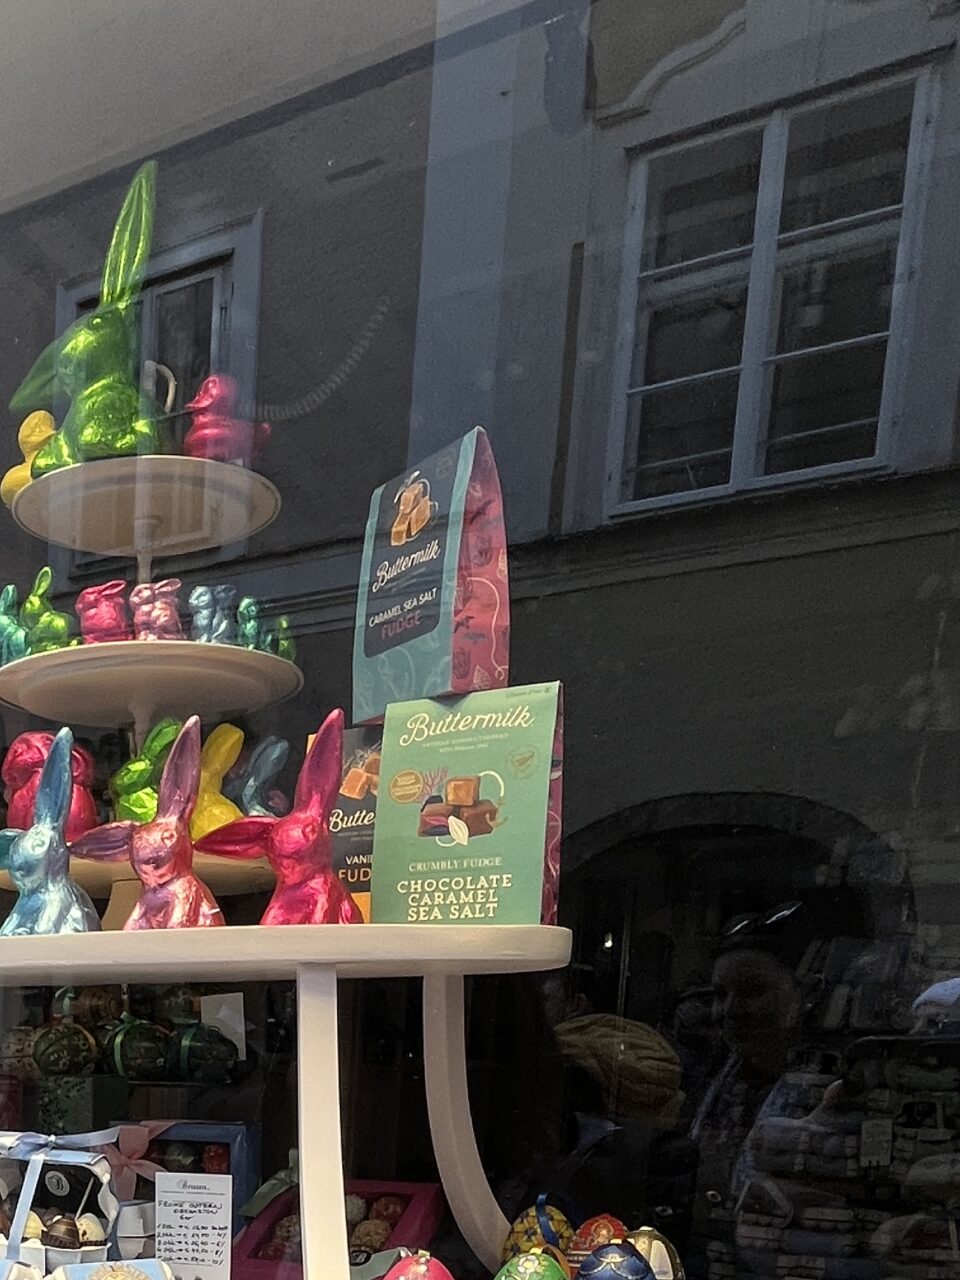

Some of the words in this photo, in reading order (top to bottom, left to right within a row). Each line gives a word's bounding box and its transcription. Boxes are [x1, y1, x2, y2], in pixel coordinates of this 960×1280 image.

[372, 539, 441, 593] Buttermilk
[368, 604, 402, 628] CARAMEL
[403, 598, 418, 611] SEA
[419, 587, 438, 605] SALT
[381, 610, 421, 640] FUDGE
[399, 705, 536, 747] Buttermilk
[329, 808, 376, 833] Butte
[408, 858, 460, 873] CRUMBLY
[462, 856, 503, 869] FUDGE
[396, 873, 513, 895] CHOCOLATE
[407, 889, 499, 907] CARAMEL
[407, 907, 443, 922] SEA
[448, 902, 499, 920] SALT
